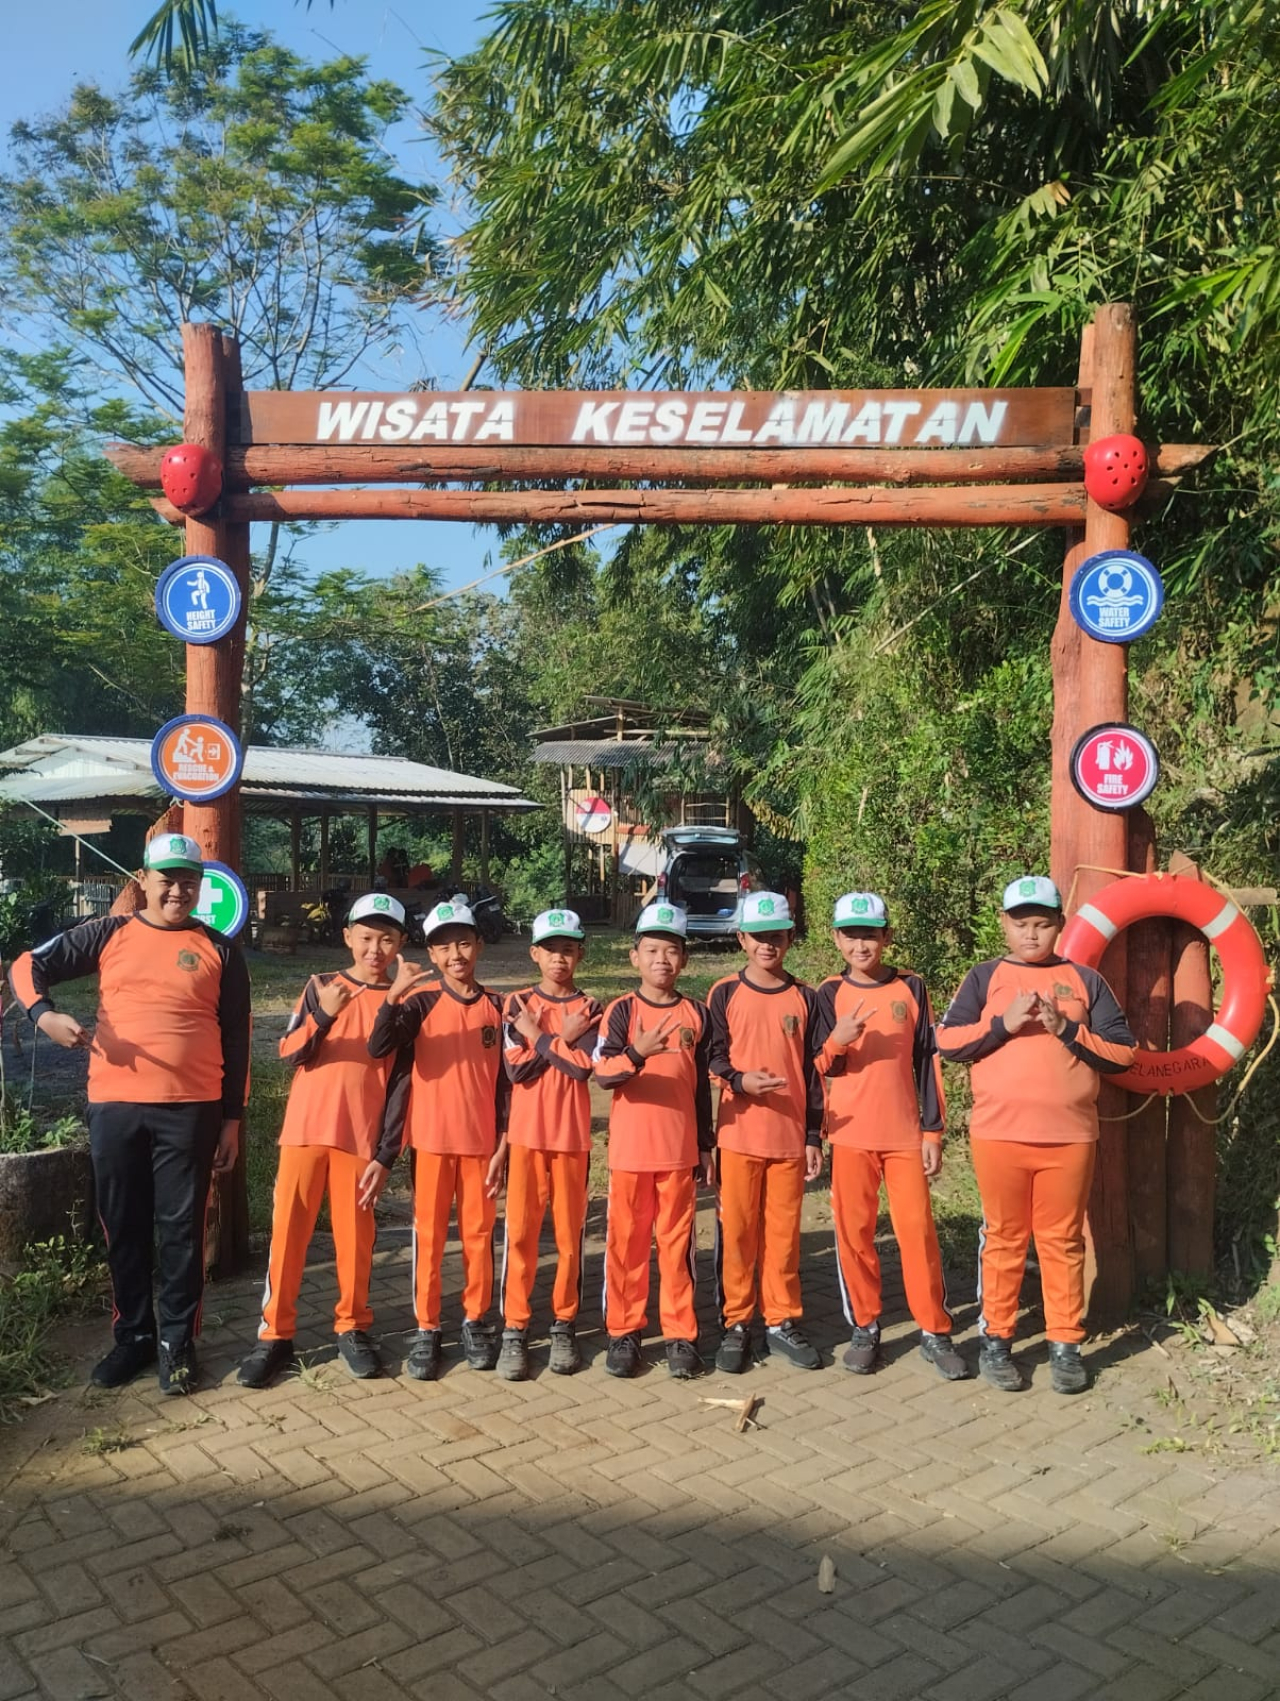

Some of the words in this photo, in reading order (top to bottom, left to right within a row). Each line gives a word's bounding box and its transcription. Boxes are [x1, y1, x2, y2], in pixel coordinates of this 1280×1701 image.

[315, 400, 515, 441] WISATA
[570, 399, 1008, 444] KESELAMATAN
[186, 609, 216, 621] HEIGHT
[1099, 606, 1129, 617] WATER
[187, 620, 216, 630] SAFETY
[1098, 617, 1130, 628] SAFETY
[1104, 774, 1123, 784] FIRE
[1096, 783, 1129, 796] SAFETY
[1128, 1057, 1210, 1078] ELANEGARA
